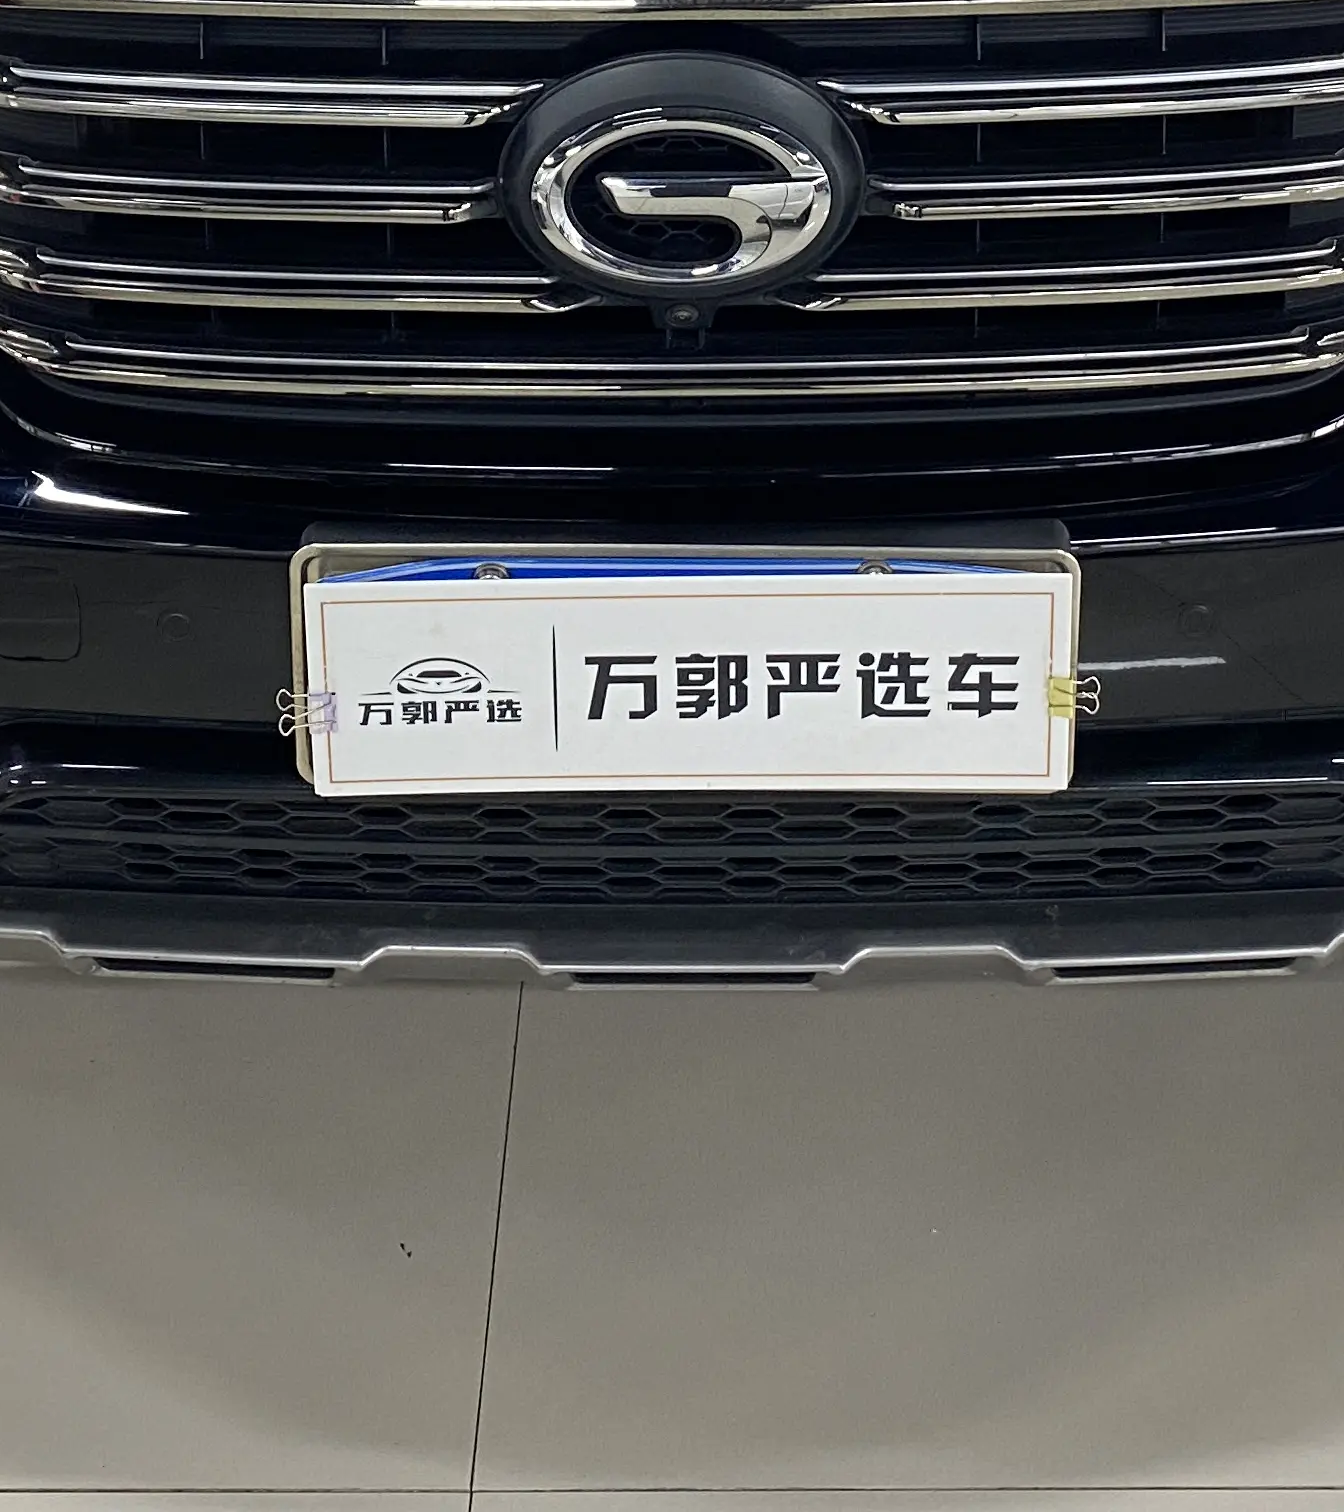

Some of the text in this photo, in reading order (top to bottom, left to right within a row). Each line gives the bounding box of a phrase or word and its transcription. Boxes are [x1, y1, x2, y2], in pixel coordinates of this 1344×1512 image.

[585, 652, 1020, 720] 万郭严选车
[358, 698, 523, 726] 万郭严选
